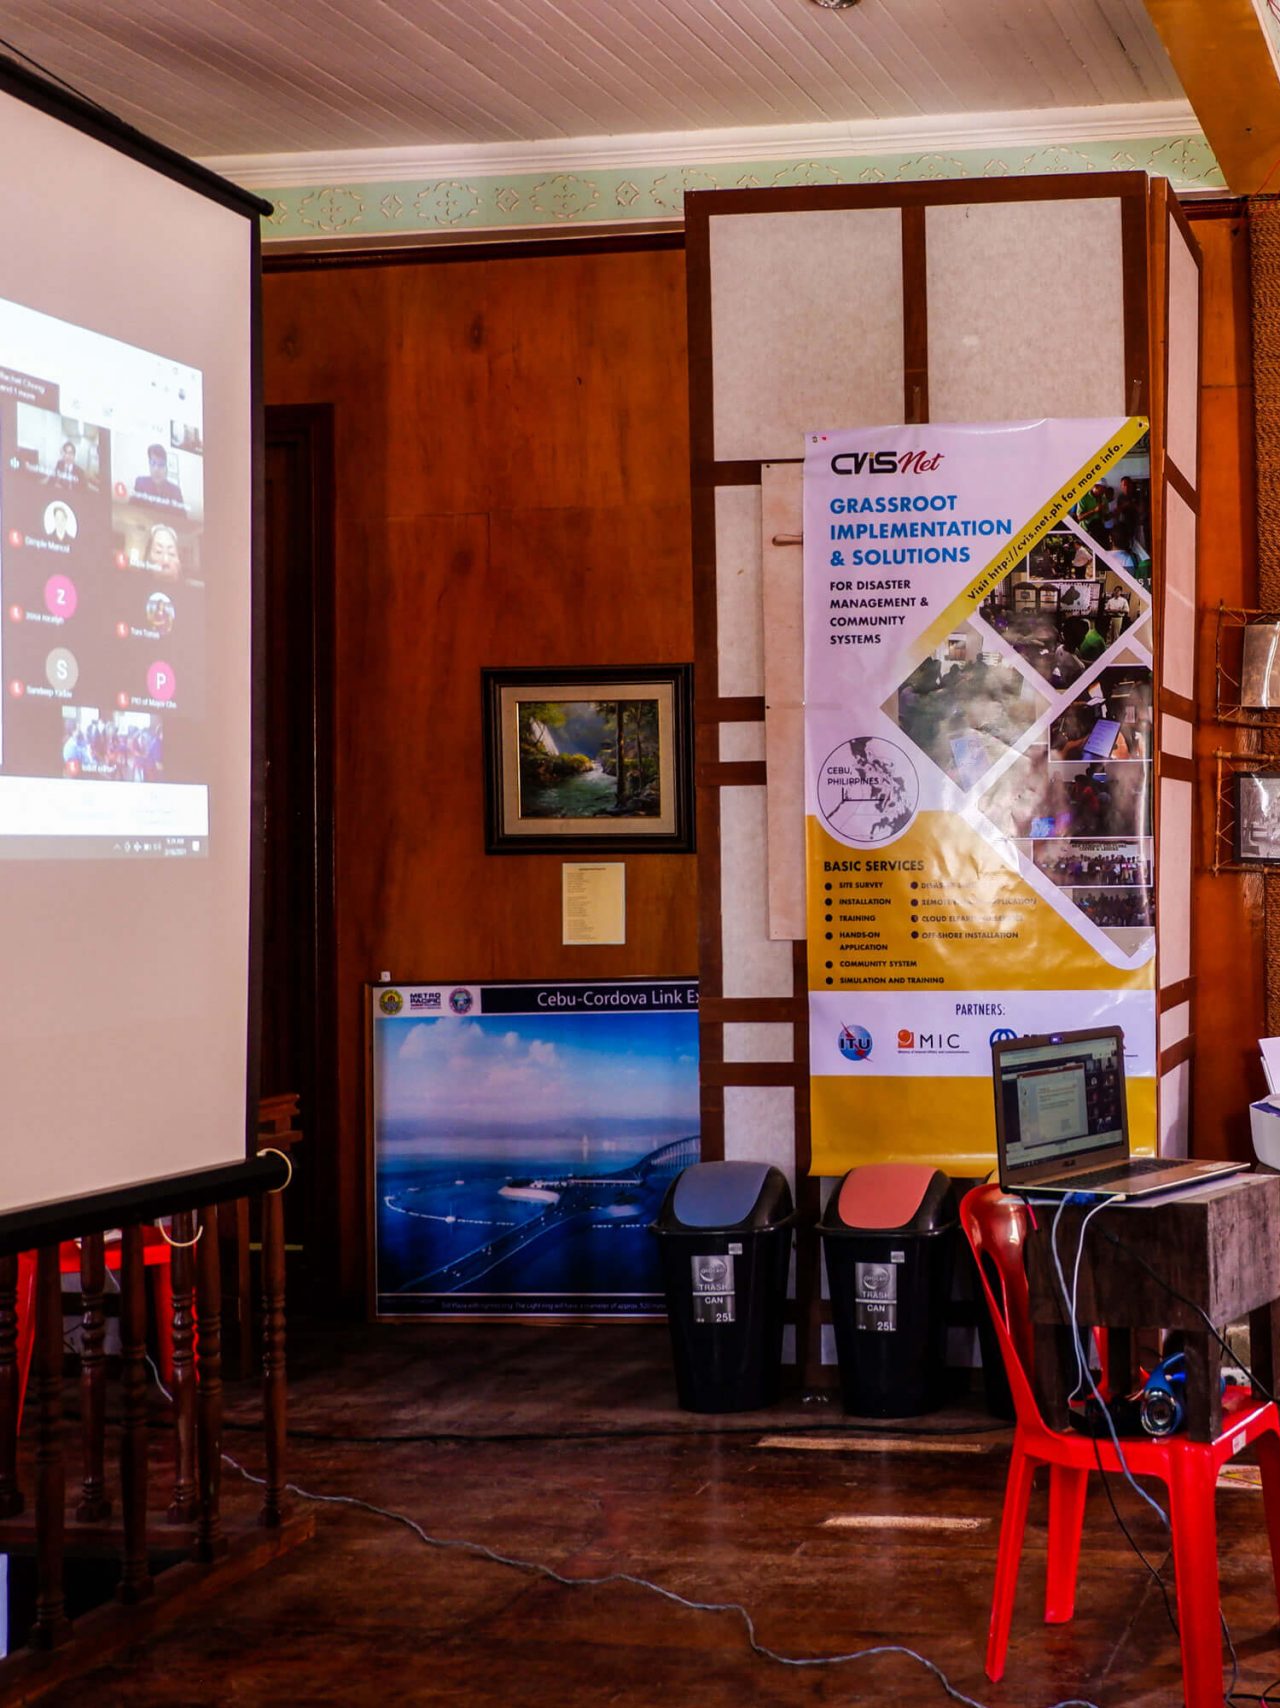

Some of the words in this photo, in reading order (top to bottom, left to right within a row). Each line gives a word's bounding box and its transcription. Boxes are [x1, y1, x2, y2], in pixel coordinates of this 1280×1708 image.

[830, 495, 957, 514] GRASSROOT
[968, 579, 989, 600] Visit
[988, 504, 1062, 580] http://cvis.net.ph
[1062, 487, 1078, 503] for
[1078, 464, 1101, 488] more
[1101, 443, 1123, 464] info.
[830, 519, 1012, 540] IMPLEMENTATION
[830, 551, 845, 566] &
[852, 547, 970, 566] SOLUTIONS
[830, 581, 853, 591] FOR
[856, 580, 911, 590] DISASTER
[830, 597, 916, 609] MANAGEMENT
[919, 597, 928, 607] &
[830, 616, 905, 627] COMMUNITY
[830, 634, 881, 645] SYSTEMS
[57, 660, 68, 680] S
[156, 673, 166, 689] P
[827, 767, 852, 779] CEBU,
[827, 777, 879, 785] PHILIPPINES
[824, 862, 861, 872] BASIC
[865, 861, 924, 871] SERVICES
[840, 931, 880, 939] HANDS-ON
[537, 991, 647, 1006] Cebu-Cordova
[652, 990, 682, 1004] Link
[955, 1003, 1006, 1017] PARTNERS:
[840, 1037, 871, 1050] ITU
[919, 1033, 960, 1049] MIC
[699, 1283, 728, 1291] TRASH
[704, 1296, 723, 1304] CAN
[867, 1304, 885, 1312] CAN
[716, 1312, 735, 1323] 25L
[877, 1321, 896, 1331] 25L
